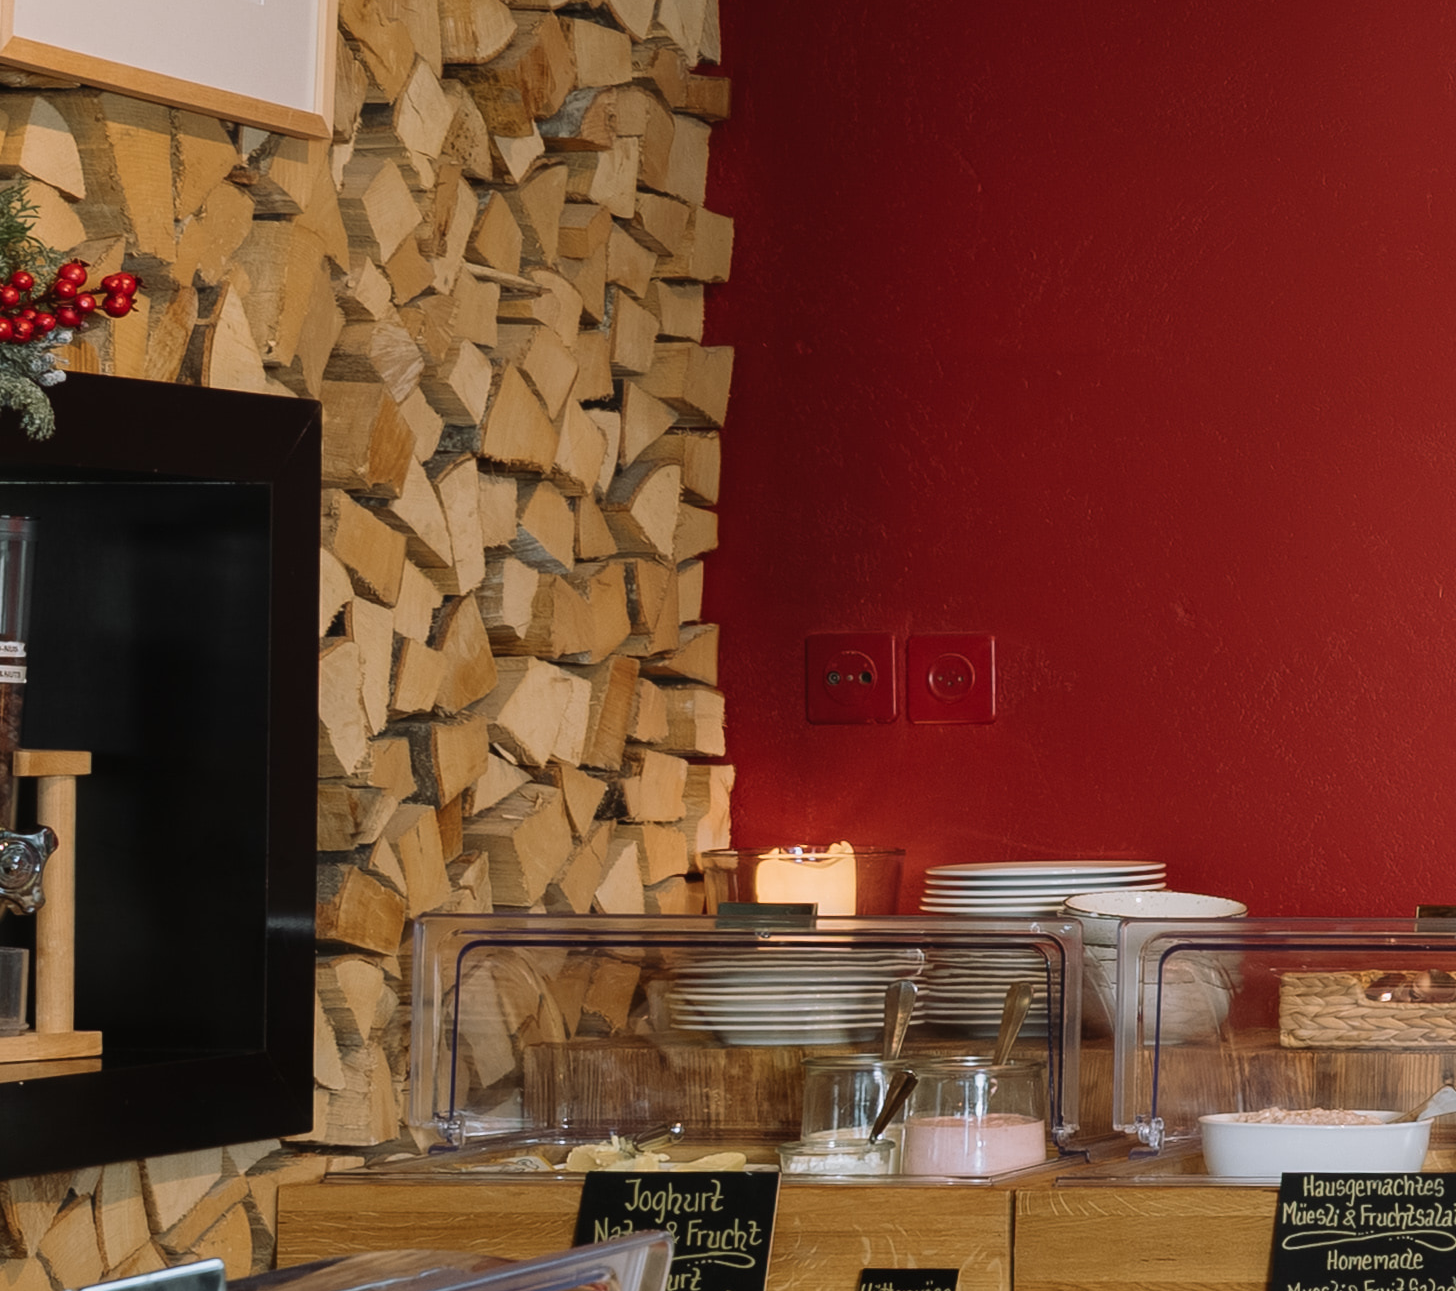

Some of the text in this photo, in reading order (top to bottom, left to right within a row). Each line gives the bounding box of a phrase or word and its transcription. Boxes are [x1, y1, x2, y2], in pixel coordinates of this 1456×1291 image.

[624, 1177, 725, 1224] Joghurt
[1302, 1174, 1445, 1207] Hausgemachtes
[1281, 1200, 1341, 1228] Müesli
[1342, 1209, 1357, 1229] &
[686, 1218, 763, 1252] Frucht
[1326, 1248, 1425, 1271] Homemade
